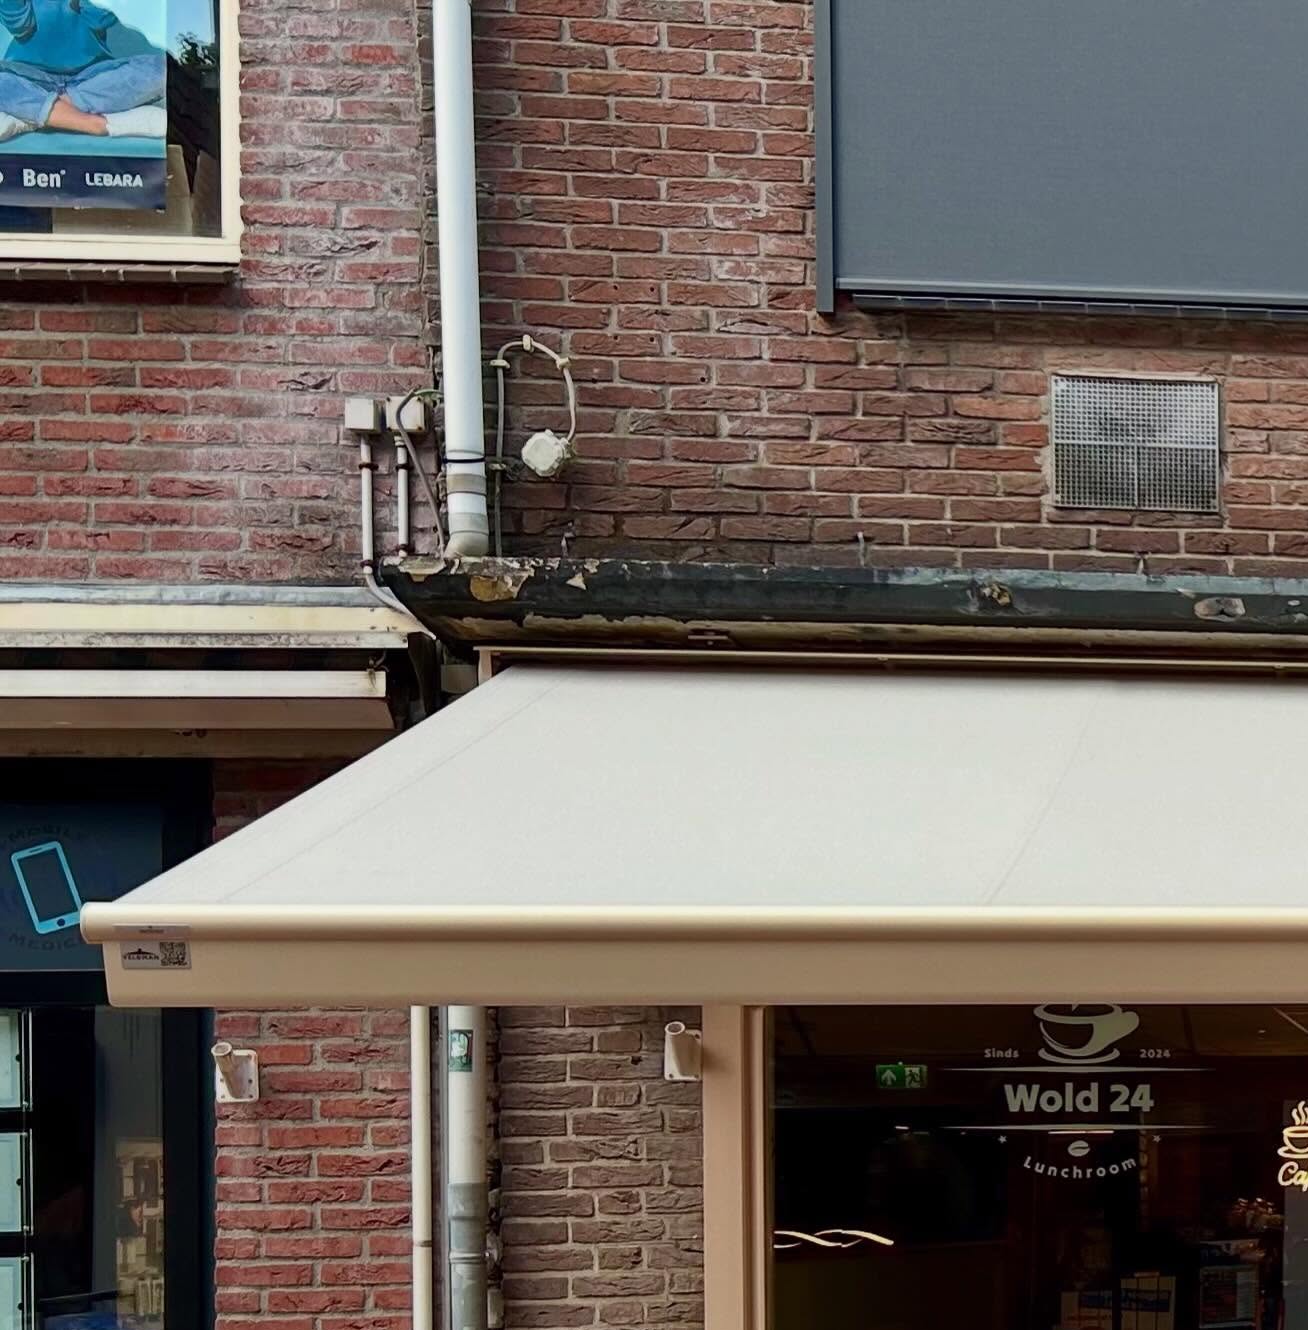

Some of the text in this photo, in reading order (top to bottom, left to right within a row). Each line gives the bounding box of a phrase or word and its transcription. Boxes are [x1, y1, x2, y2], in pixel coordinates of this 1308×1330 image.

[85, 172, 144, 188] LEBARA
[983, 1048, 1172, 1059] Sinds 2024
[1004, 1082, 1155, 1113] Wold 24
[1023, 1156, 1137, 1179] Lunchroom
